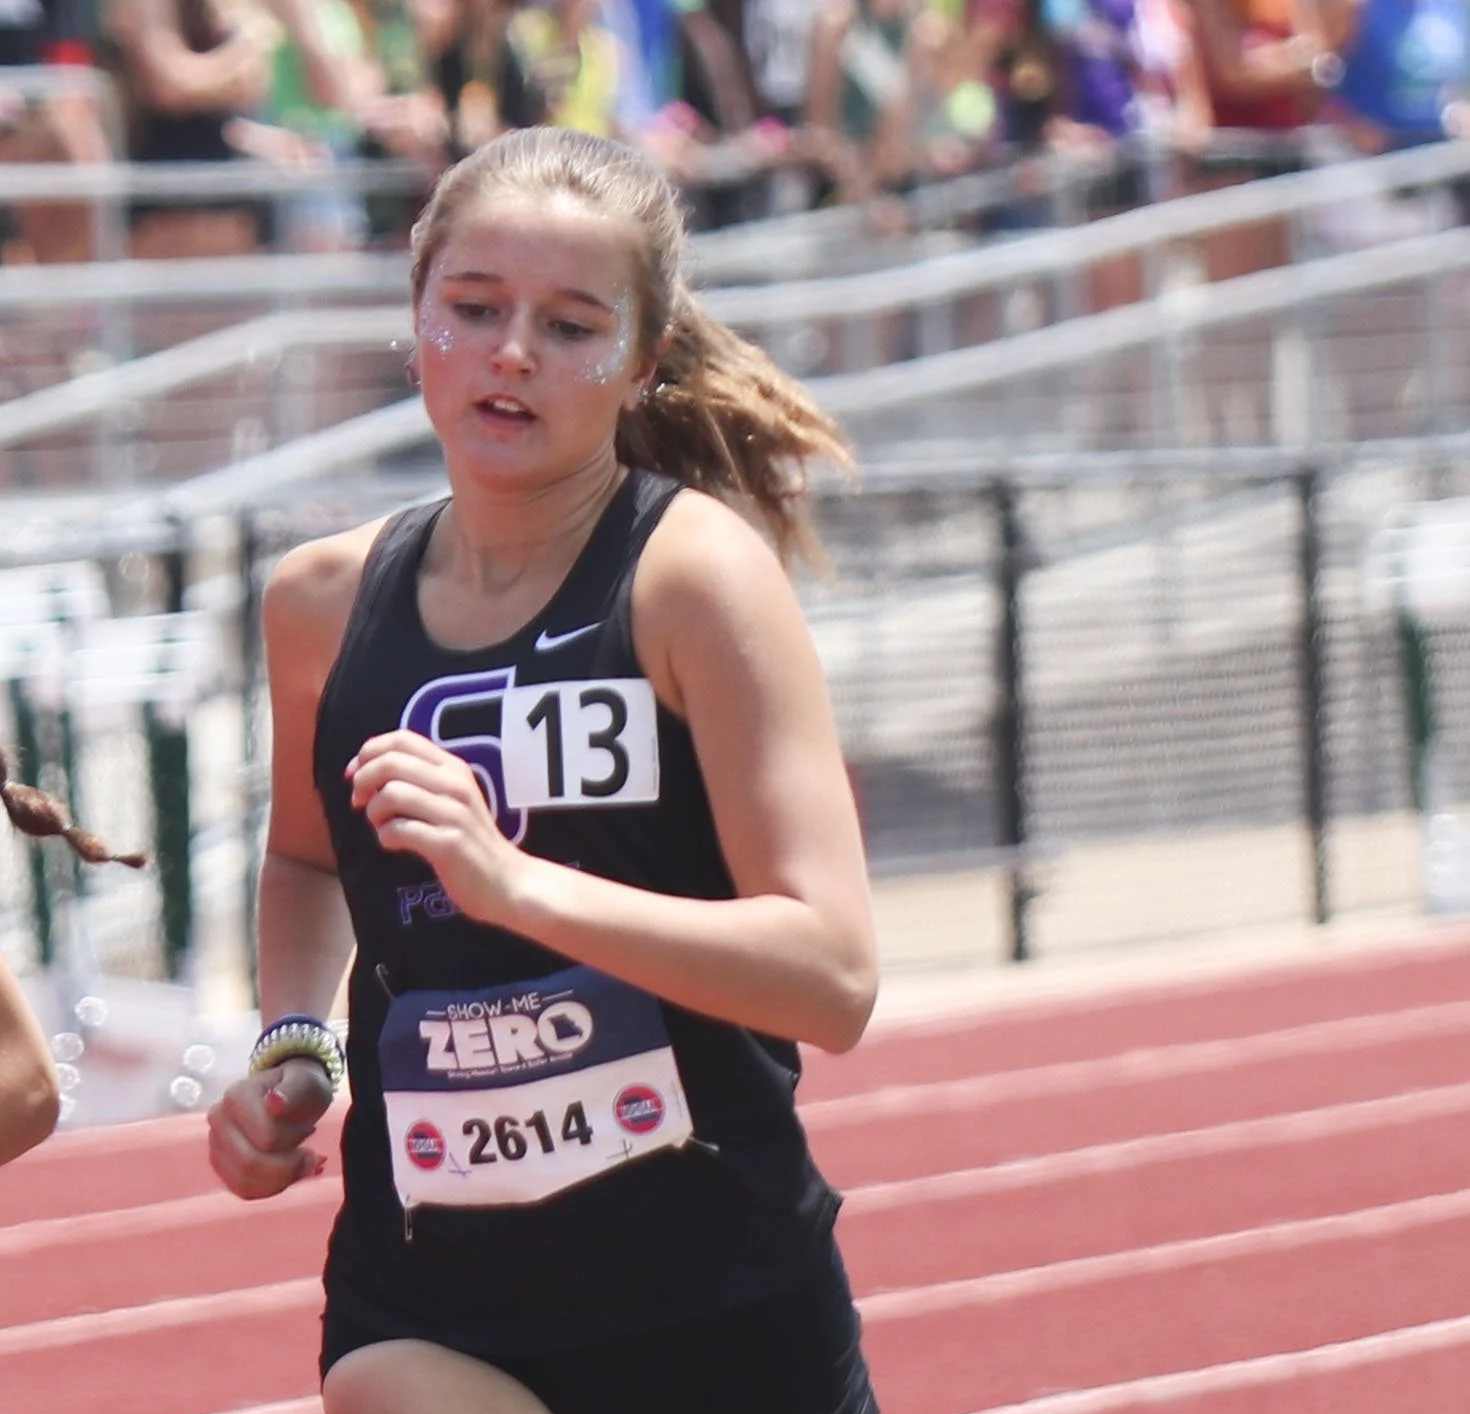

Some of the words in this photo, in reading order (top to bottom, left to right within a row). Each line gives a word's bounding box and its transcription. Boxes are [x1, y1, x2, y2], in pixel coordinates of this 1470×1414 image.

[526, 686, 630, 798] 13
[419, 1001, 593, 1070] ZERO
[462, 1101, 593, 1165] 2614
